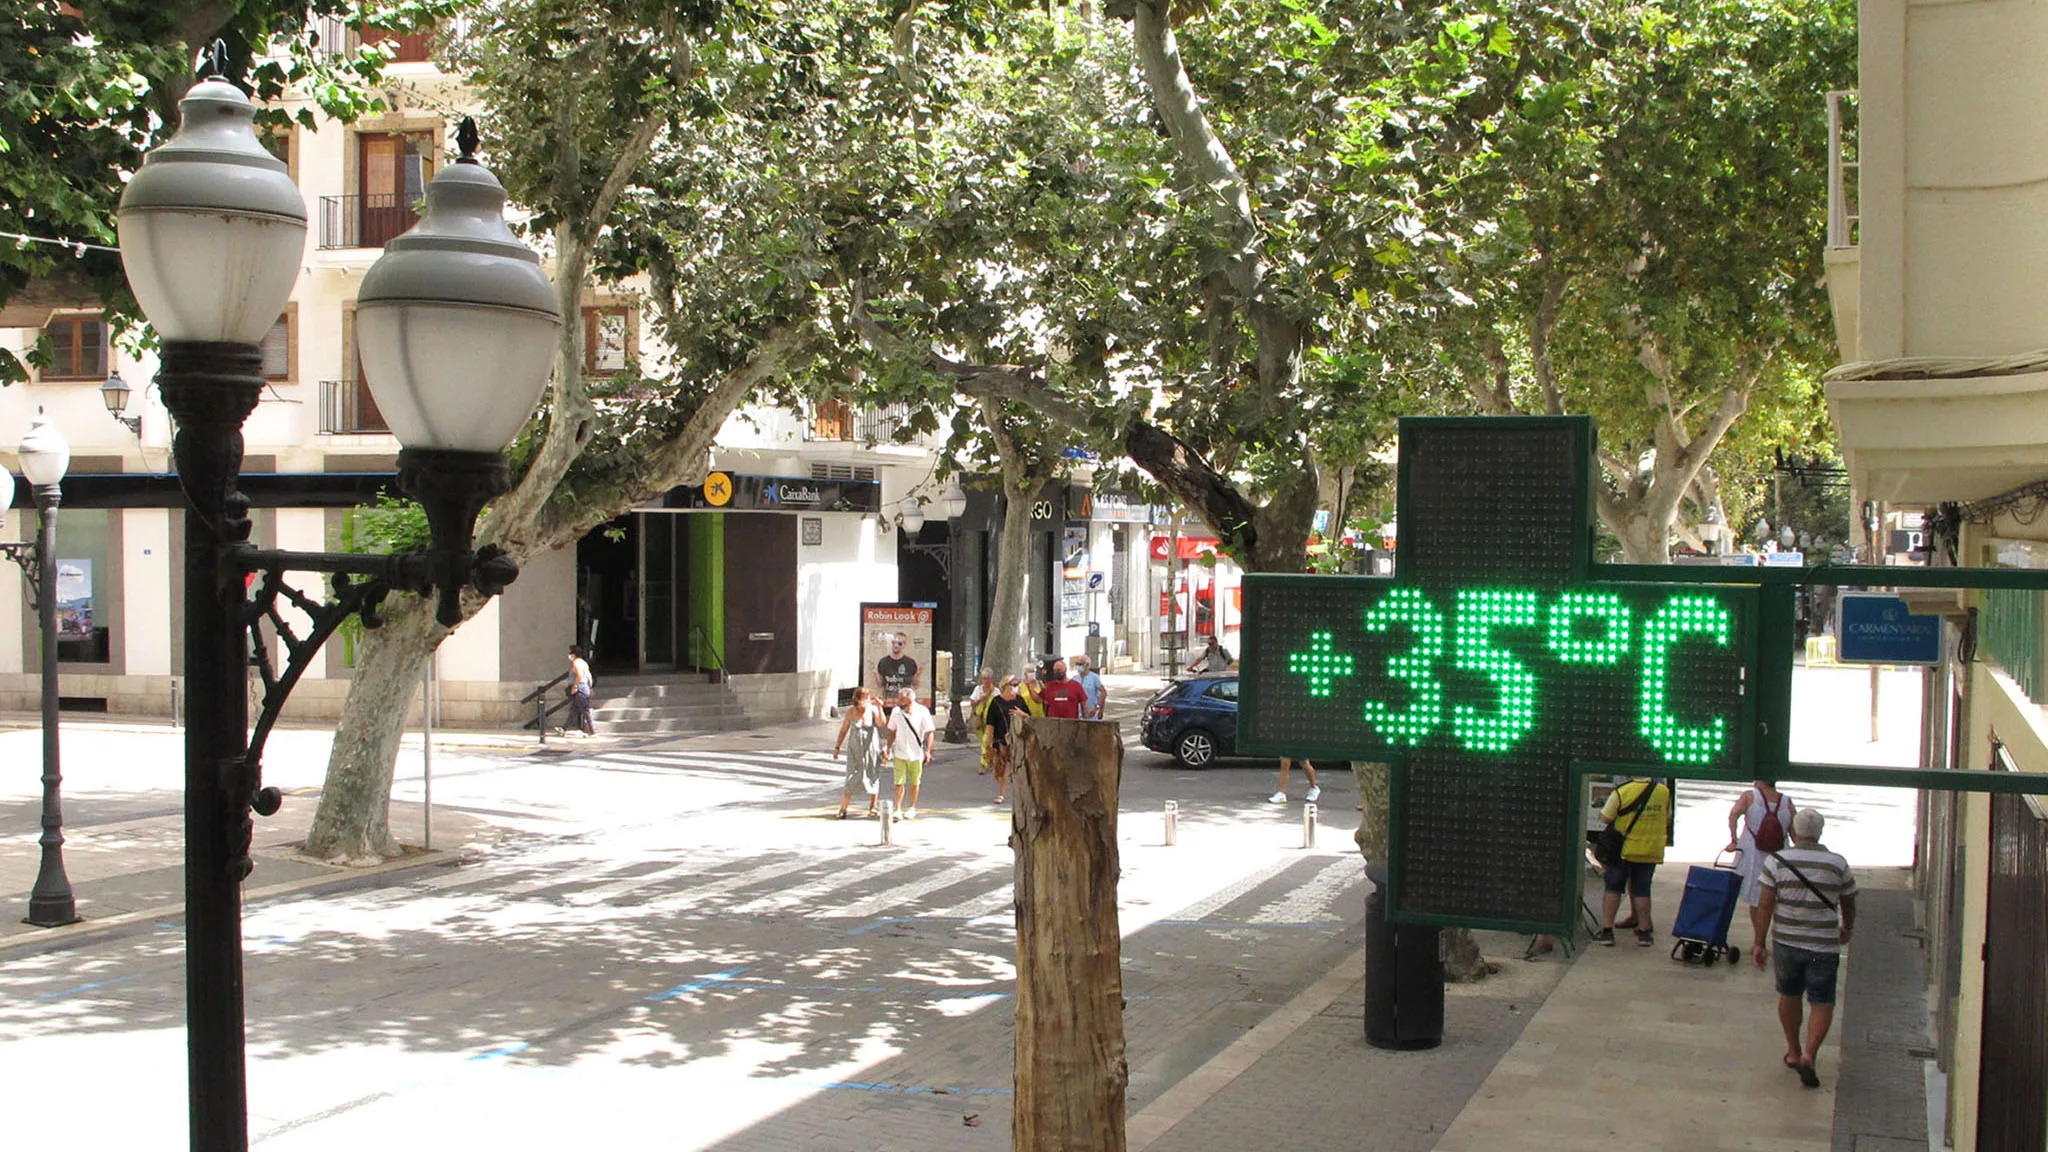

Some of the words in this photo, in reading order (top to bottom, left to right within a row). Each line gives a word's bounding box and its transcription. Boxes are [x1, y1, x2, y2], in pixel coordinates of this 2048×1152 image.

[780, 484, 820, 501] CaixaBank
[868, 610, 893, 620] Robin
[894, 611, 915, 621] Look
